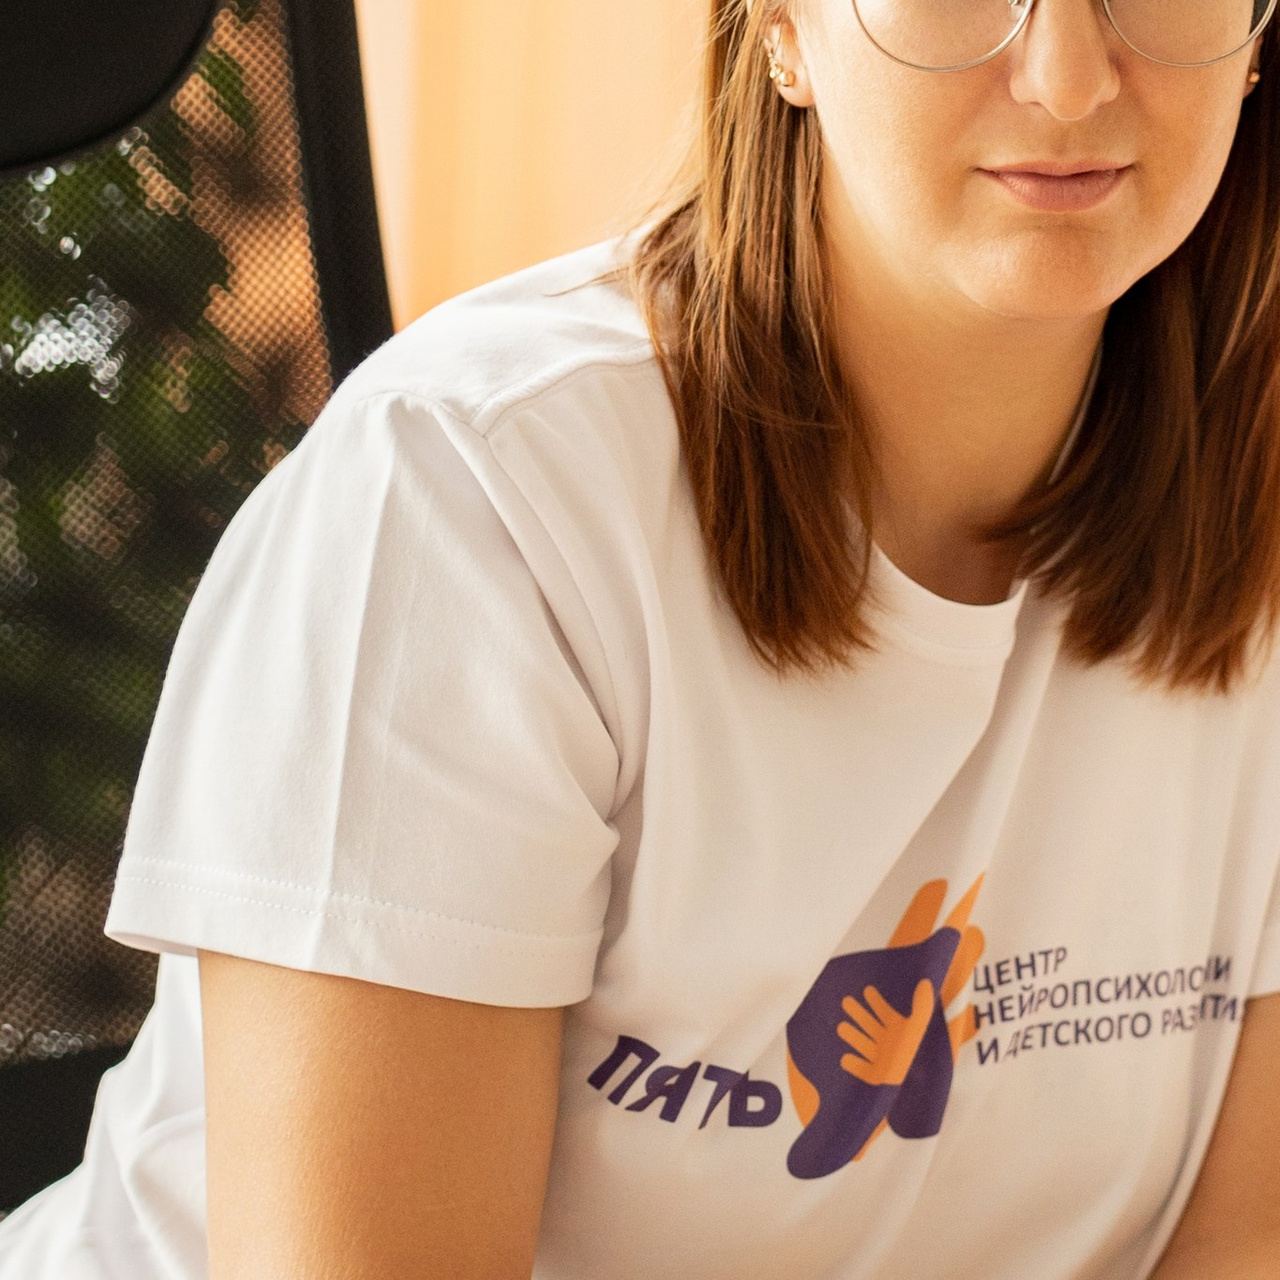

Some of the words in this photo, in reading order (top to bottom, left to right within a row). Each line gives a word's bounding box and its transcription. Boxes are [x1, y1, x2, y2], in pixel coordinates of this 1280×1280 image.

[973, 946, 1068, 994] ЦЕНТР
[974, 954, 1233, 1029] НЕЙРОПСИХОЛОИ
[976, 1037, 999, 1065] И
[1002, 1011, 1152, 1061] ДЕТСКОГО
[587, 1035, 783, 1130] ПЯТЬ
